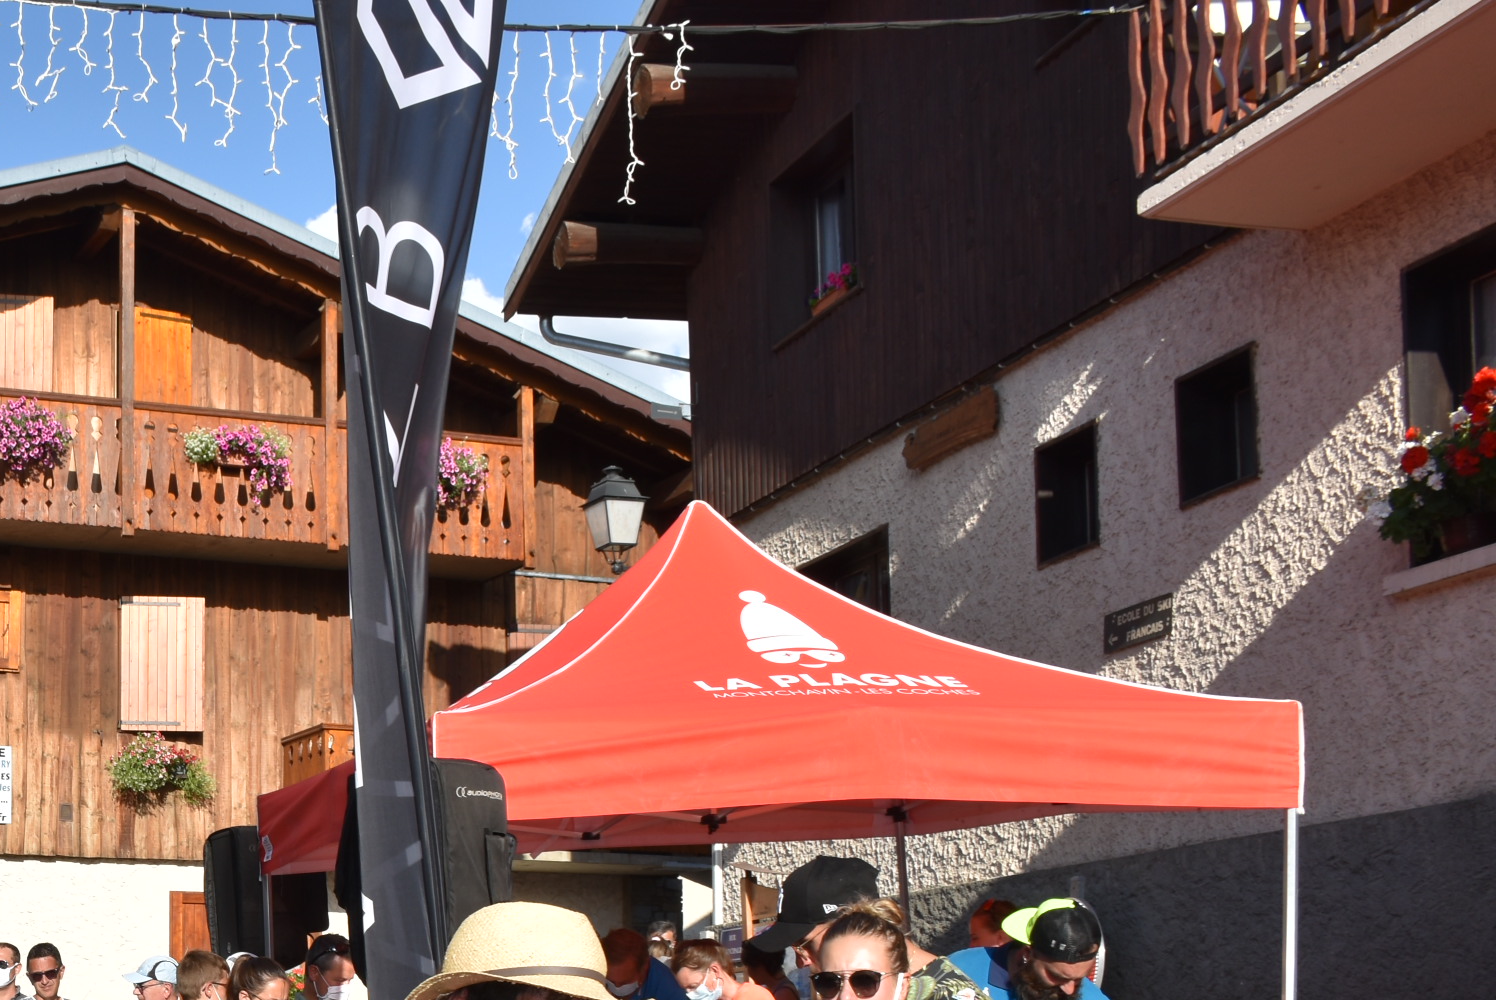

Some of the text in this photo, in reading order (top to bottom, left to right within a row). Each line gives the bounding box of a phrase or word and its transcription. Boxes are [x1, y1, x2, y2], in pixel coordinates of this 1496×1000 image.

[1117, 597, 1172, 626] ECOLE DU SKI
[1126, 620, 1164, 642] FRANCAIS
[693, 672, 969, 691] LA PLAGNE
[712, 688, 854, 699] MONTCHAVIN
[861, 687, 893, 695] LES
[896, 688, 981, 696] COCHES
